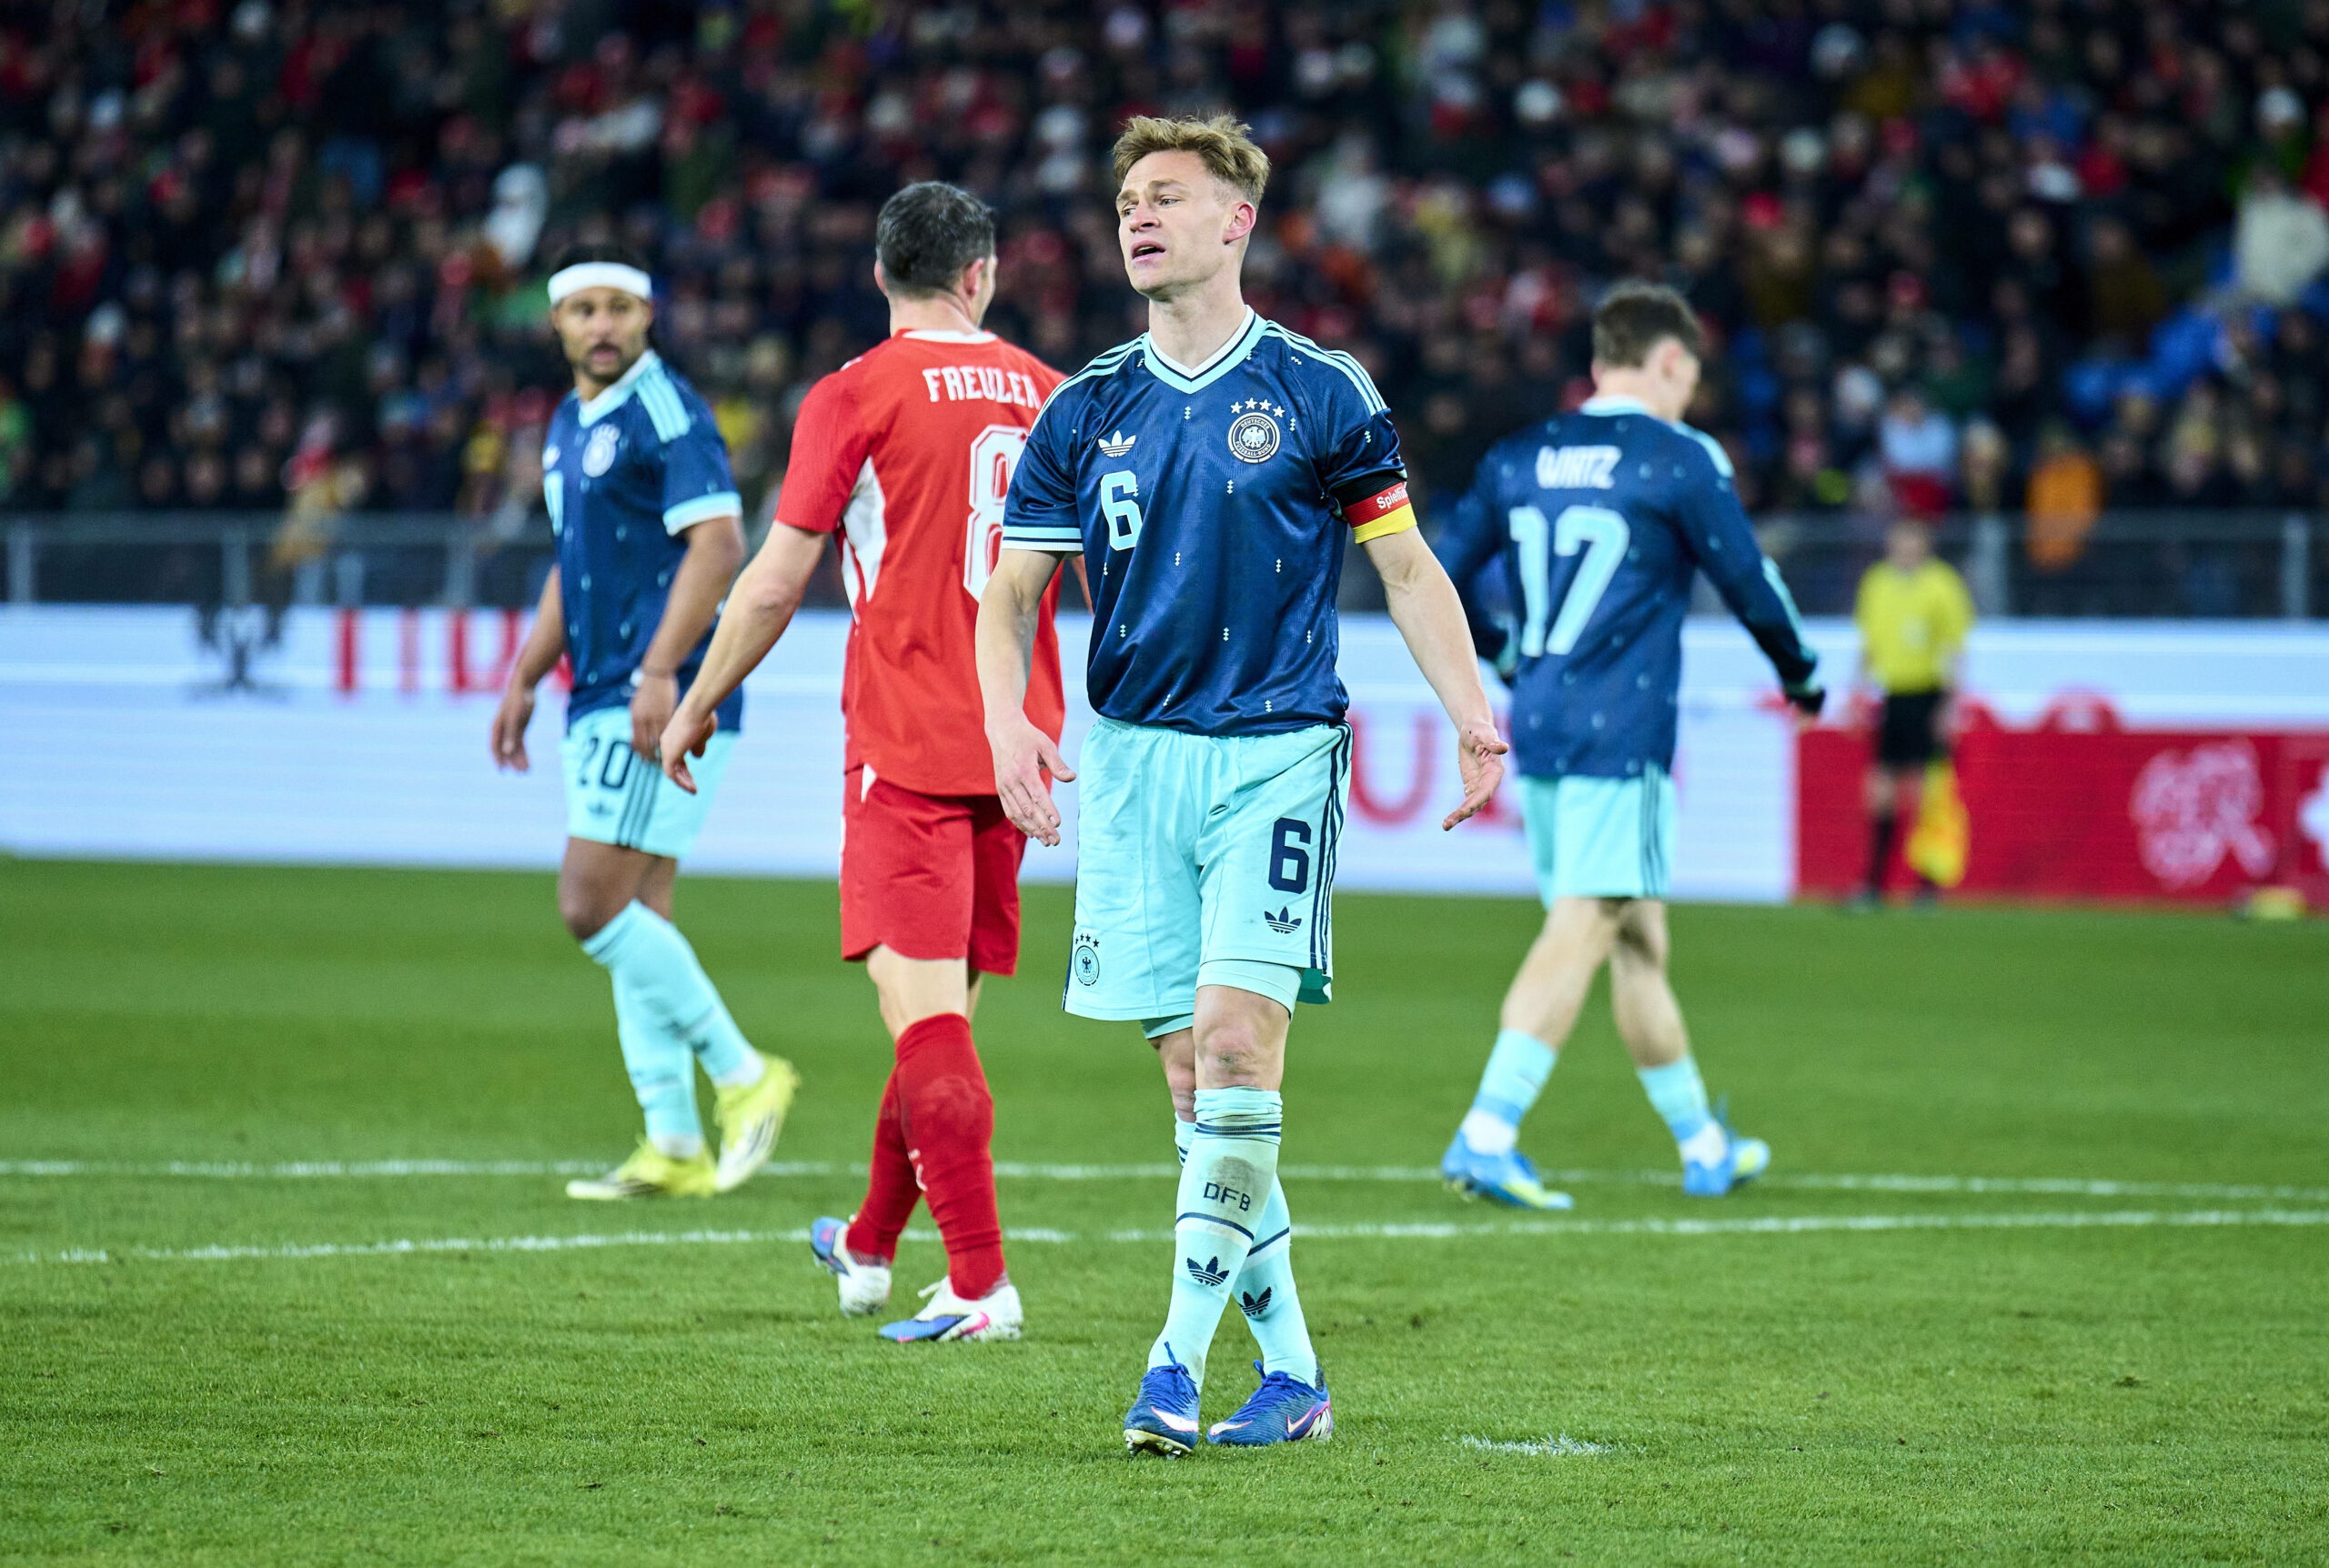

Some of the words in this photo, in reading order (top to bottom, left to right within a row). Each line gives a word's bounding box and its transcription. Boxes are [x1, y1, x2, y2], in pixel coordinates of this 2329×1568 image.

[963, 424, 1029, 604] 8
[1100, 470, 1144, 551] 6
[1508, 505, 1630, 658] 17
[1268, 817, 1311, 895] 6
[1203, 1181, 1251, 1212] DFB
